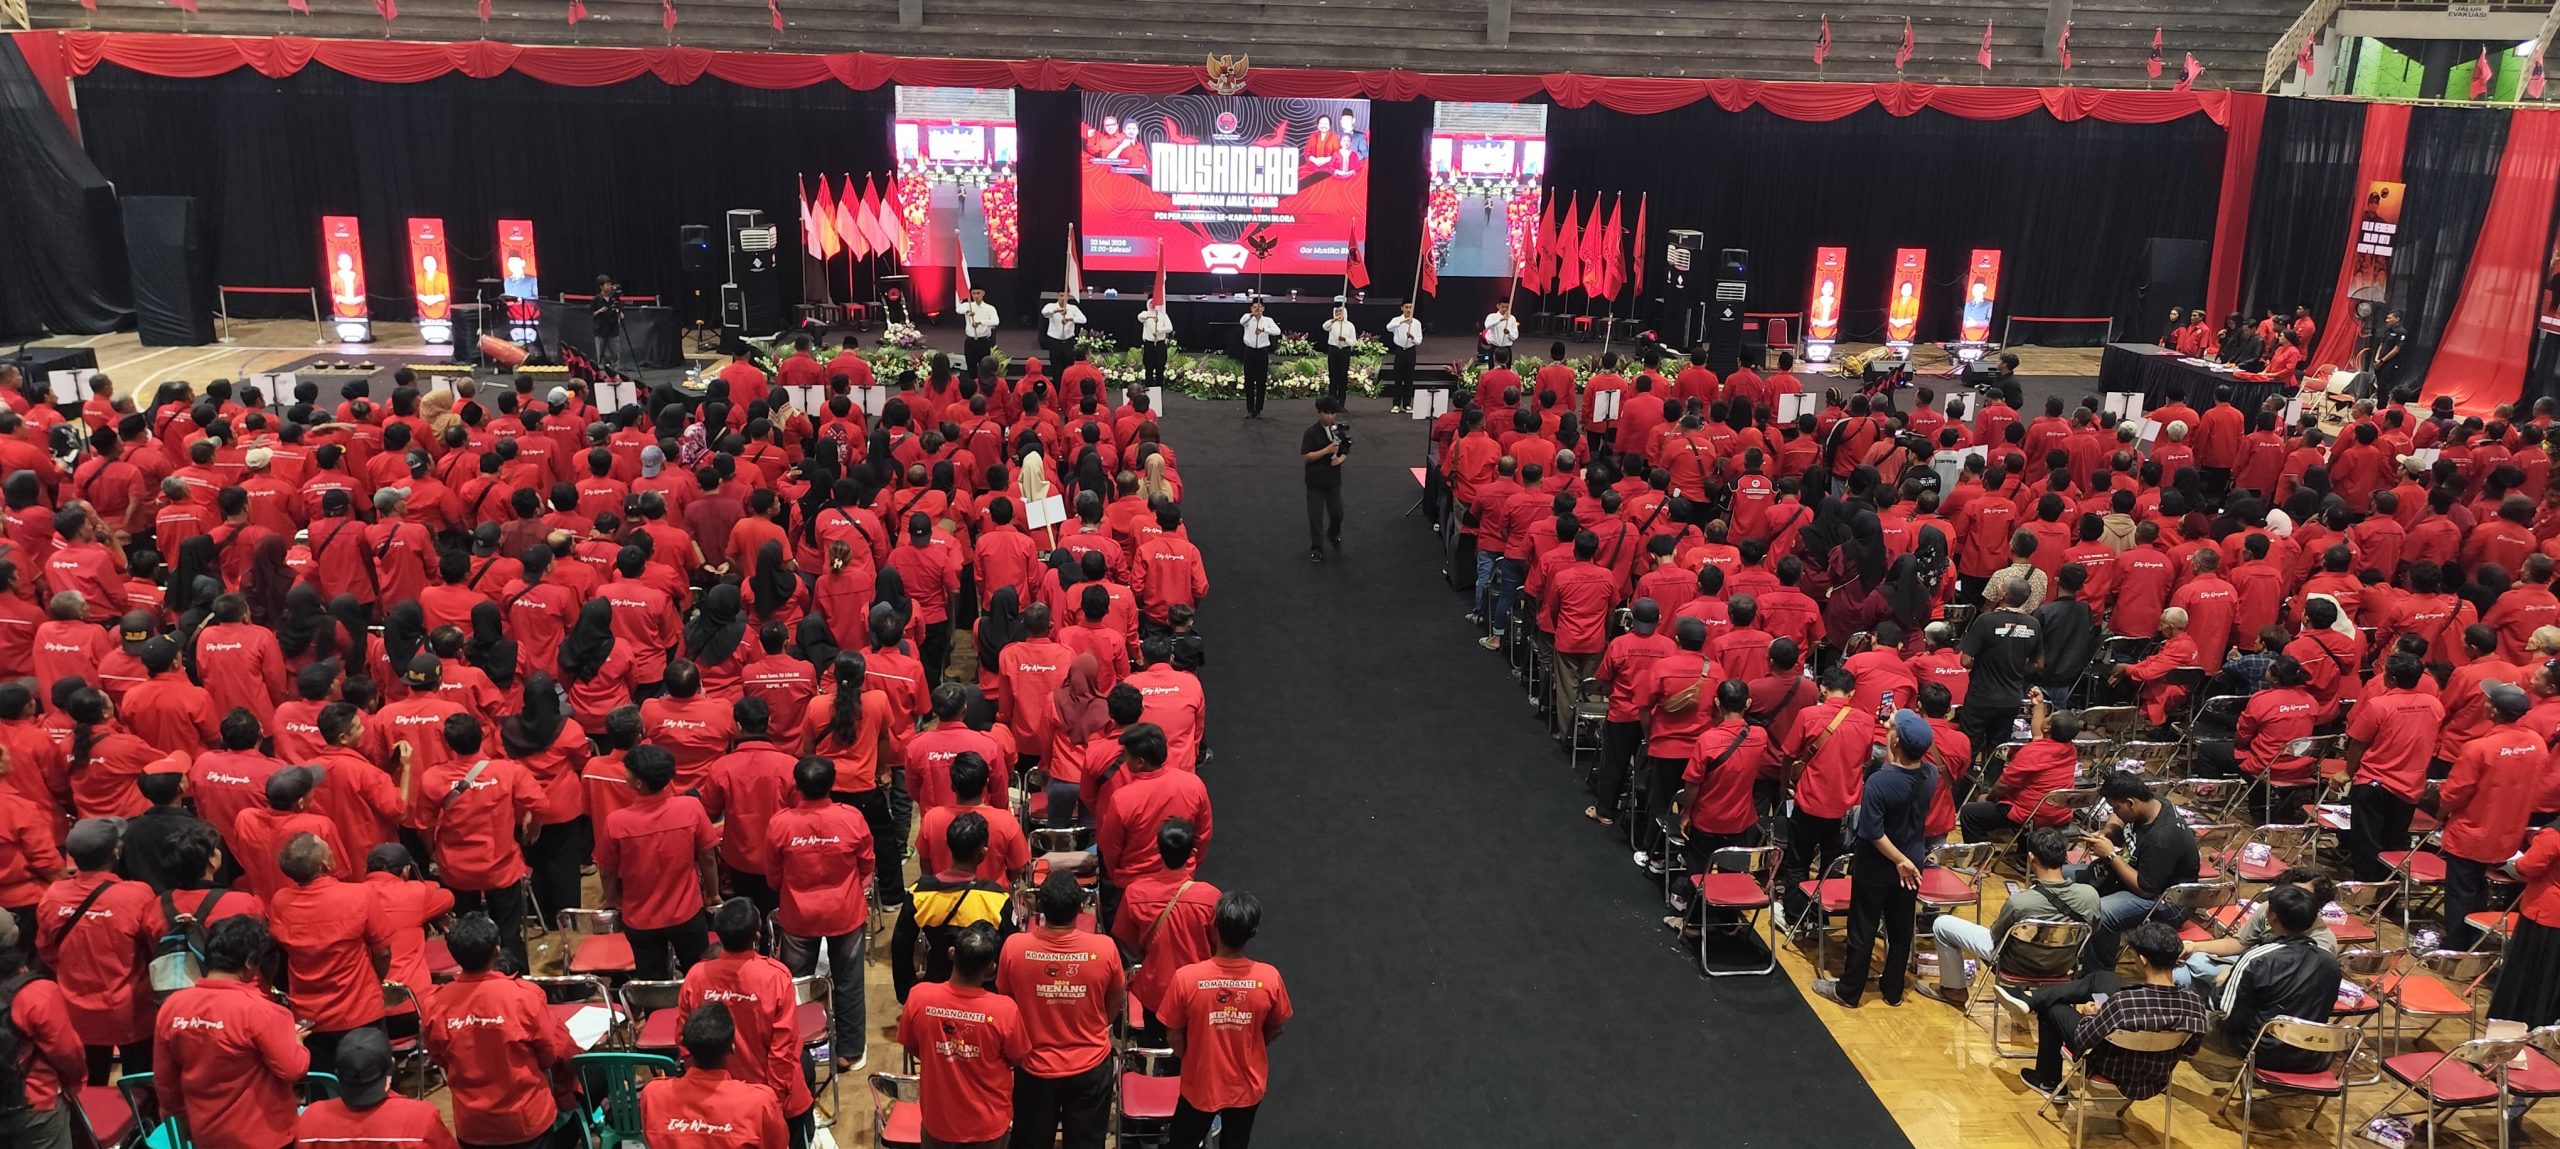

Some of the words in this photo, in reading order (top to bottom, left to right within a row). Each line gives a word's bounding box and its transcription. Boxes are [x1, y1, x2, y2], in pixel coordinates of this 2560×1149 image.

[1151, 142, 1299, 195] MUSANCAB
[1026, 951, 1088, 961] KOMANDANTE
[1065, 963, 1080, 977] 3
[1036, 984, 1087, 993] MENANG
[1198, 980, 1255, 989] KOMANDANTE
[925, 1006, 985, 1022] KOMANDANTE
[1208, 1011, 1253, 1020] MENANG
